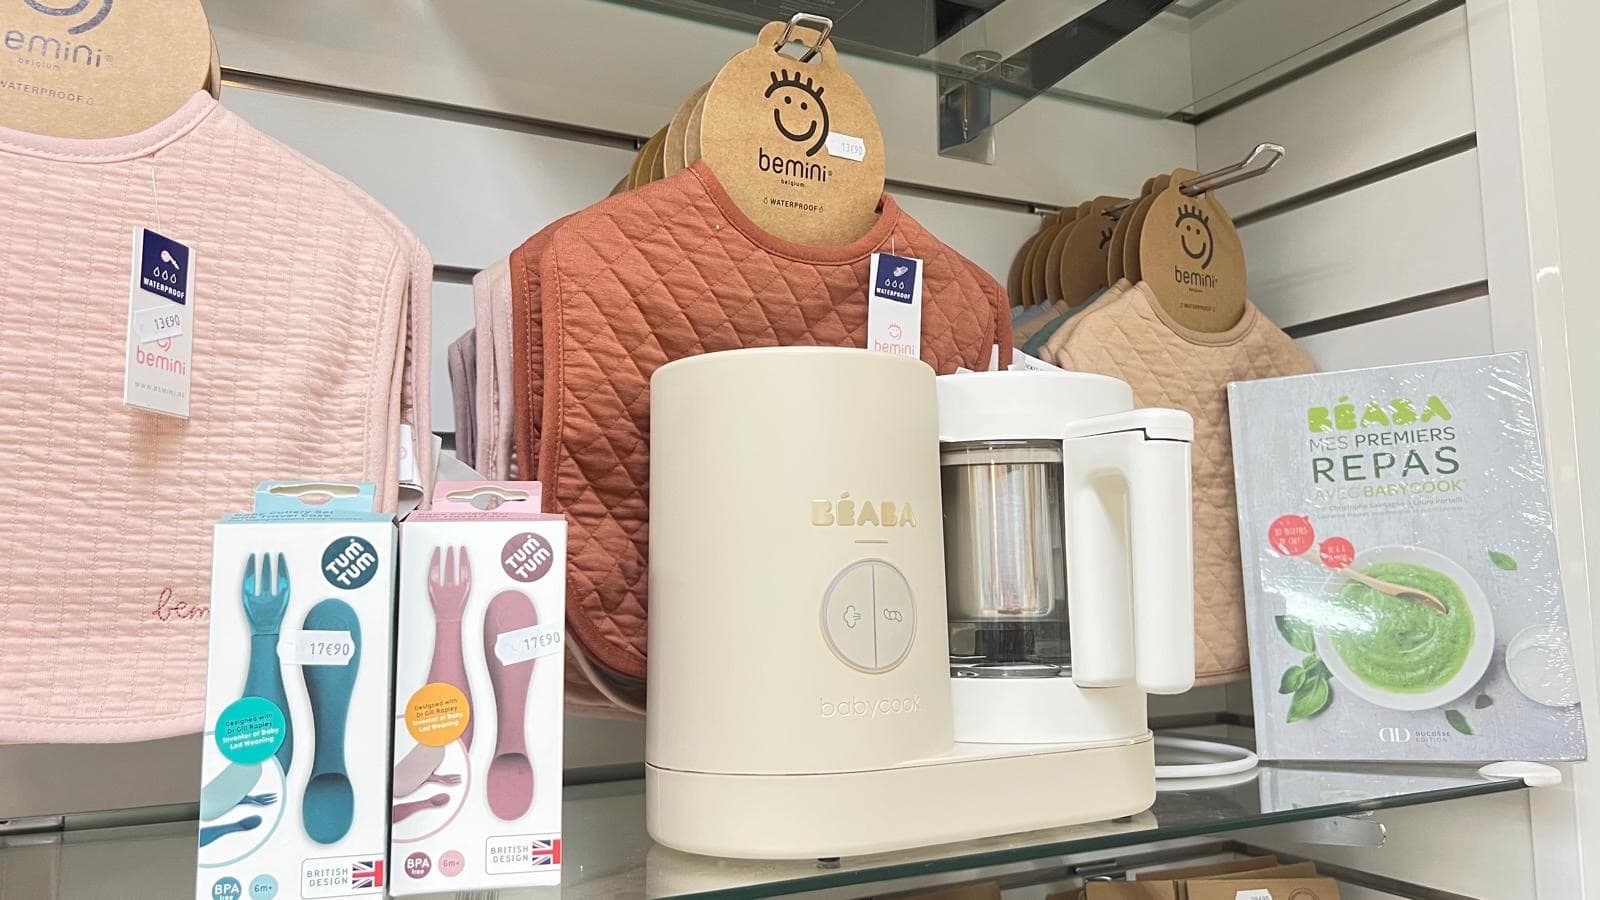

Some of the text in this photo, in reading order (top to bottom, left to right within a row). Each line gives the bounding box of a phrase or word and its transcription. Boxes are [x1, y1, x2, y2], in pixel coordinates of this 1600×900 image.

[4, 30, 102, 67] emini
[758, 147, 826, 182] bemini
[770, 198, 818, 212] WATERPROOF
[1175, 265, 1215, 288] bemini
[143, 276, 185, 299] WATERPROOF
[876, 287, 911, 300] WATERPROOF
[154, 314, 181, 331] 13€90
[874, 338, 914, 356] bemini
[136, 345, 186, 376] bemini
[1309, 426, 1456, 452] MES PREMIERS
[1312, 446, 1460, 484] REPAS
[1363, 479, 1463, 498] BABYCOOK
[811, 492, 916, 527] BÉABA
[325, 539, 365, 575] TUM
[505, 536, 541, 569] TUM
[336, 552, 376, 586] TUM
[515, 547, 551, 579] TUM
[309, 642, 350, 656] 17€90
[524, 631, 561, 650] 17€90
[414, 701, 444, 711] Designed
[819, 694, 921, 718] babycook
[225, 716, 257, 727] Designed
[249, 721, 272, 730] Rapley
[222, 732, 251, 744] Inventor
[261, 727, 279, 735] Baby
[230, 736, 274, 750] Led Weaning
[491, 845, 529, 855] BRITISH
[493, 854, 529, 863] DESIGN
[407, 858, 430, 868] BPA
[443, 859, 460, 867] 6m+
[306, 867, 348, 878] BRITISH
[214, 883, 240, 895] BPA
[254, 884, 272, 893] 6m+
[309, 877, 348, 887] DESIGN
